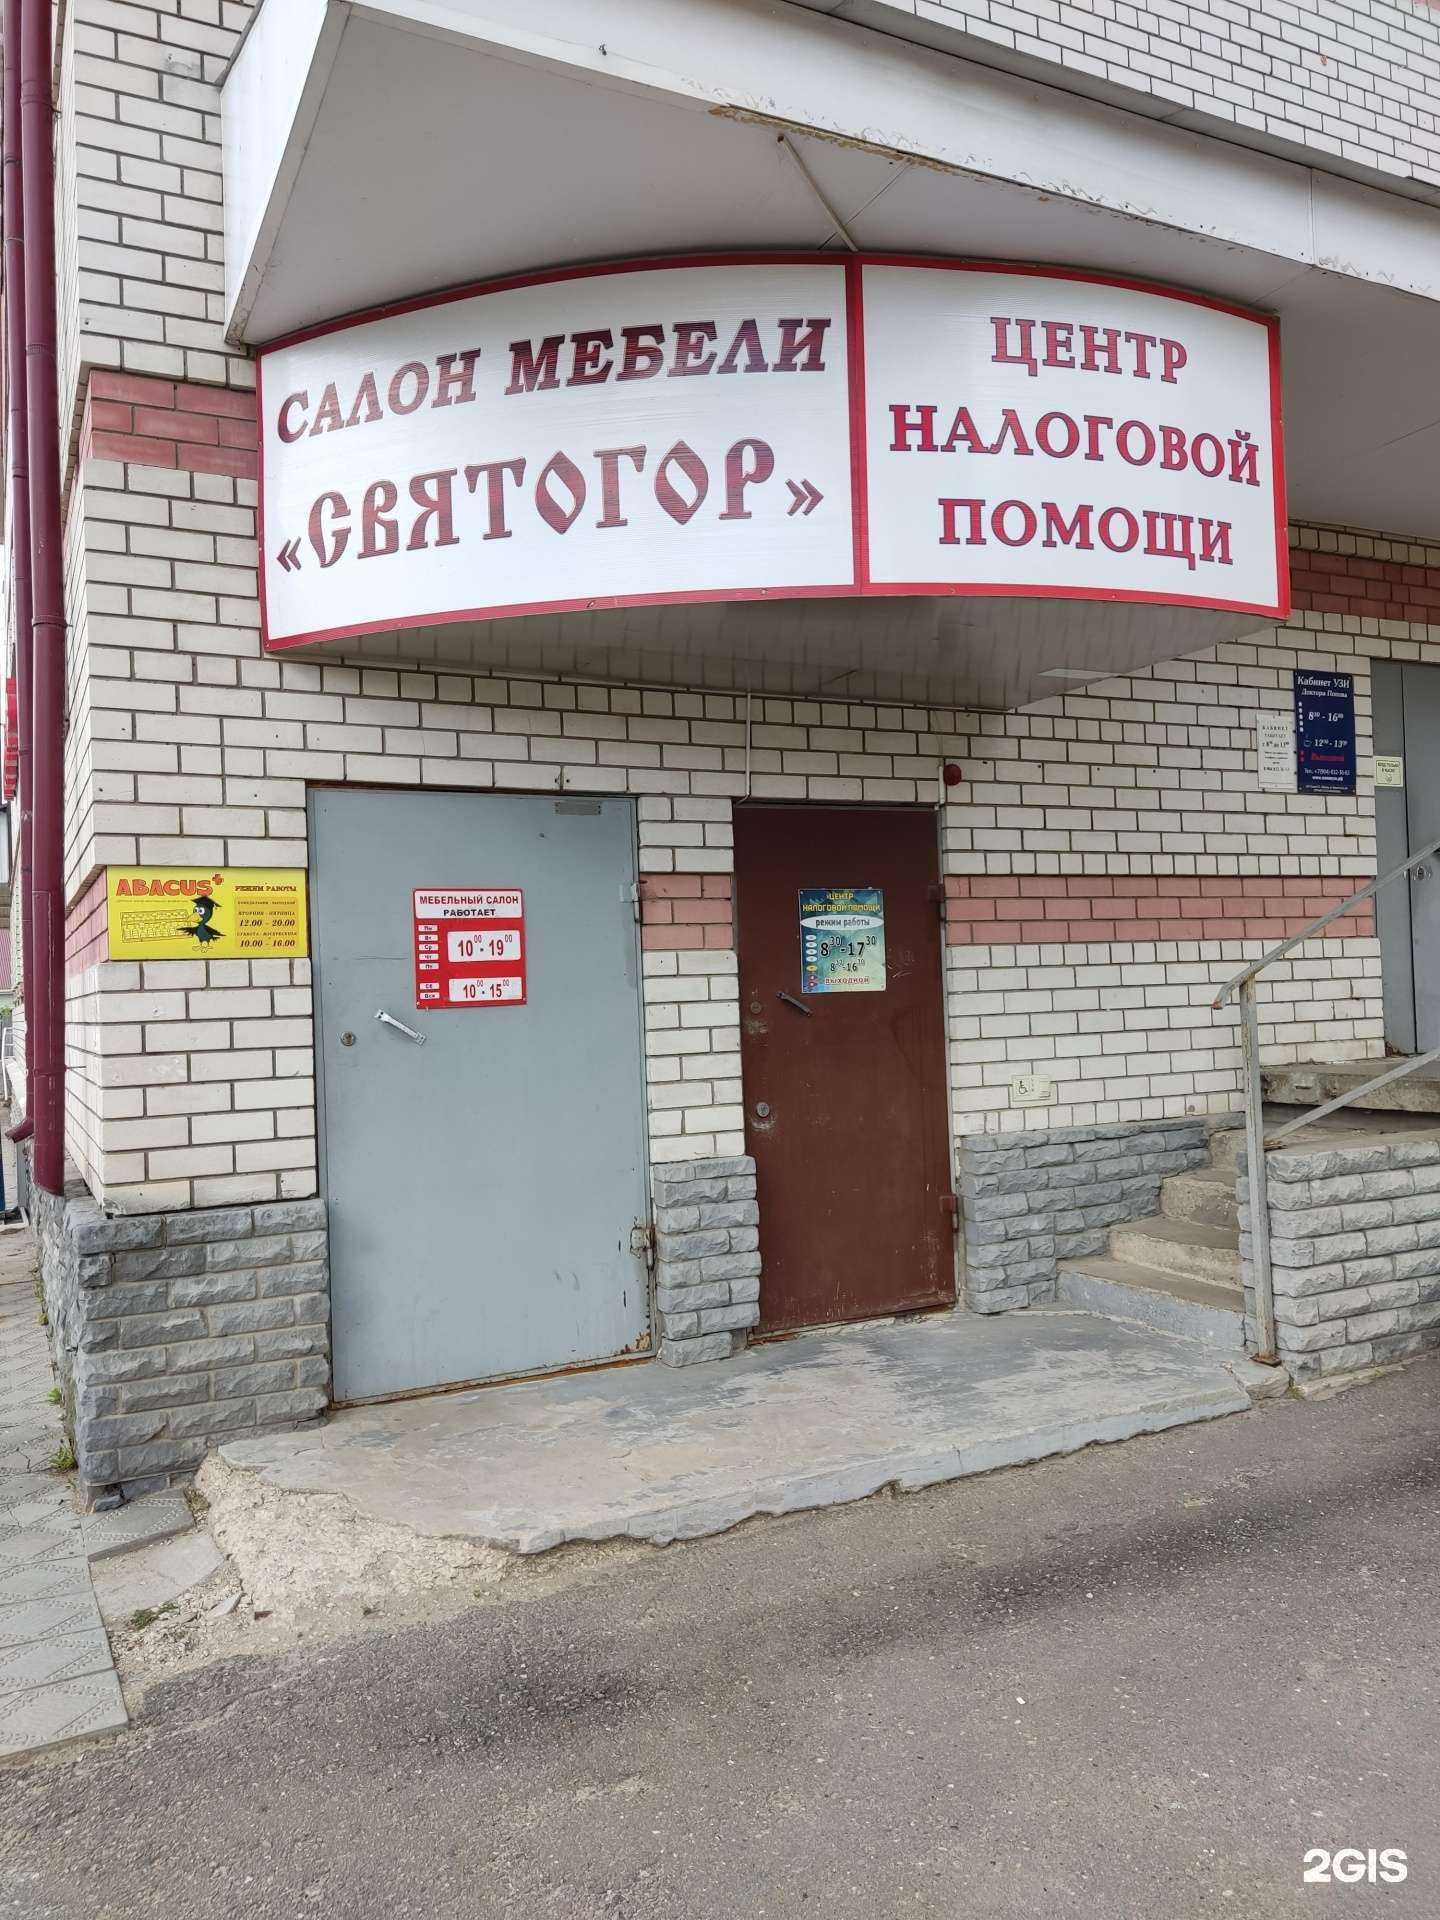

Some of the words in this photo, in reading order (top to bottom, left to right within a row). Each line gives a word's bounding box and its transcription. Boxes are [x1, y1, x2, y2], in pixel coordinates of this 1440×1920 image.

[990, 316, 1188, 384] ЦЕНТР
[277, 348, 482, 444] САЛОН
[504, 318, 832, 396] МЕБЕЛИ
[889, 404, 1261, 487] НАЛОГОВОЙ
[276, 437, 824, 573] «СВЯТОГОР»
[938, 498, 1234, 571] ПОМОЩИ
[1297, 676, 1332, 687] Кабинет
[420, 895, 483, 904] МЕБЕЛЬНЫЙ
[486, 896, 519, 904] САЛОН
[828, 892, 854, 900] ЦЕНТР
[815, 919, 841, 928] режим
[843, 917, 870, 928] работы
[240, 939, 263, 947] 10.00
[272, 939, 295, 947] 16.00
